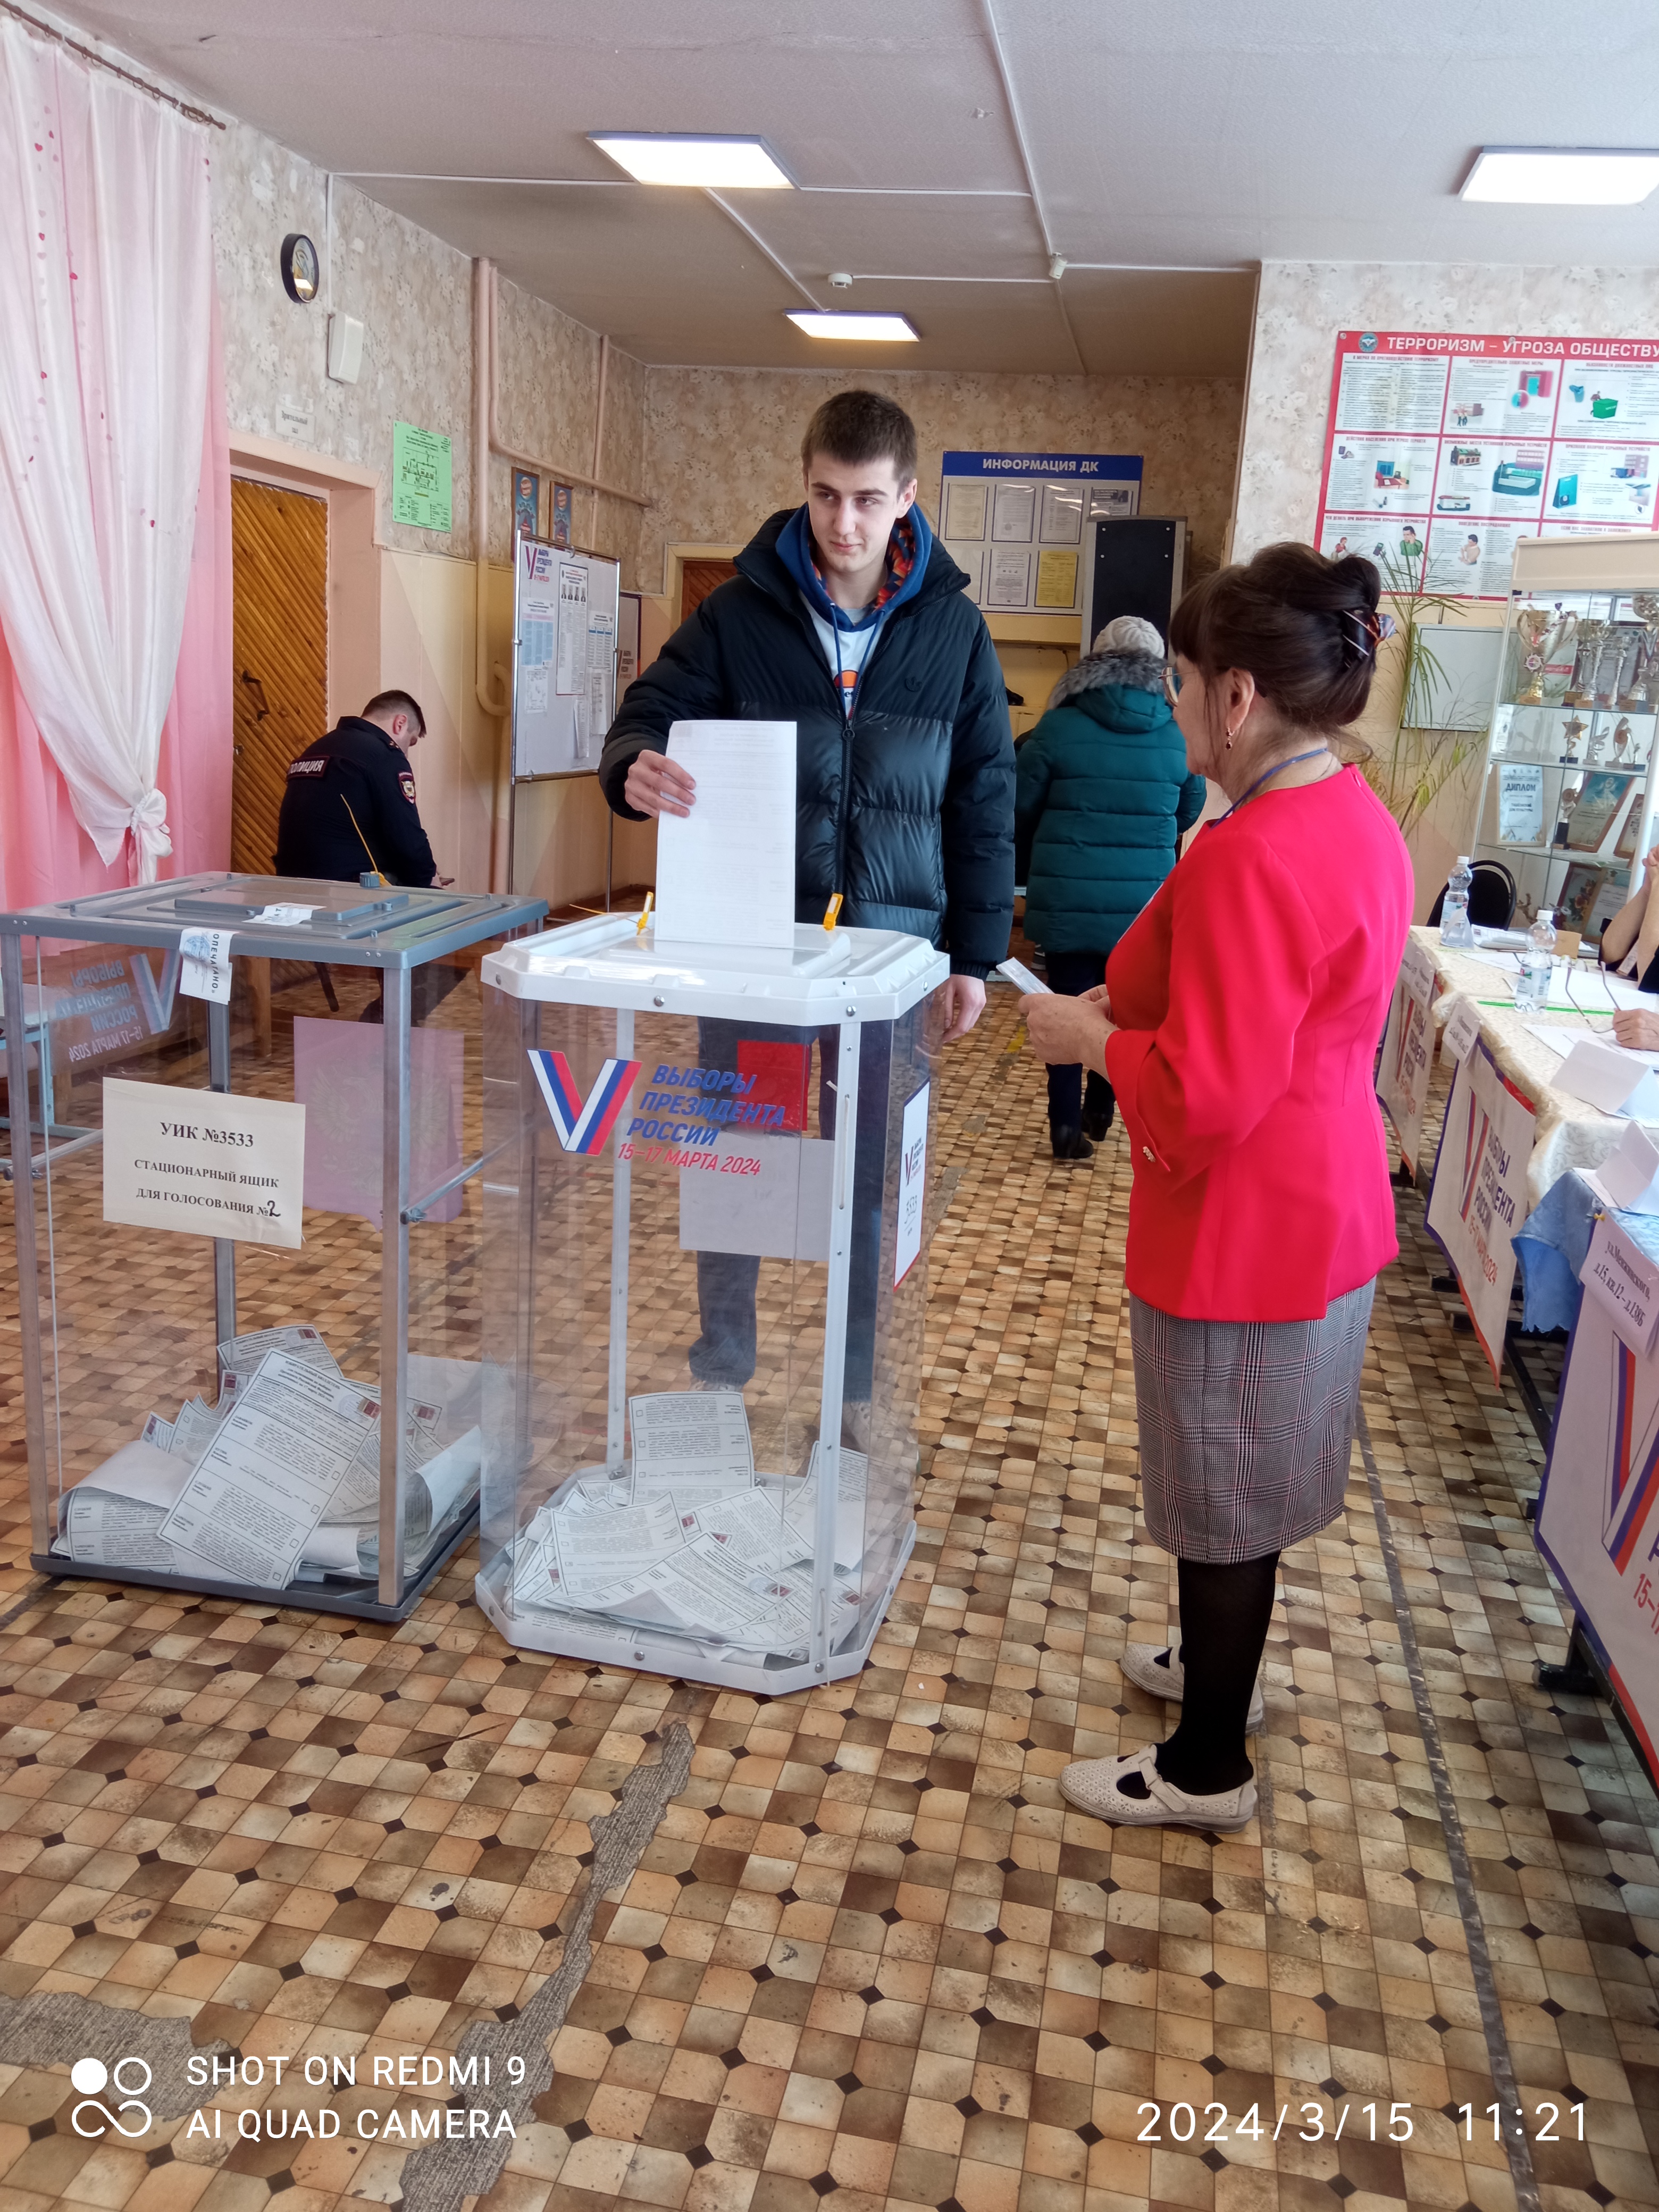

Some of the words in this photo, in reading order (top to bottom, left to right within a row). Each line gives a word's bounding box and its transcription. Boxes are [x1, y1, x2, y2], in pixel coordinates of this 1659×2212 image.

[1387, 337, 1485, 352] ТЕРРОРИЗМ
[1503, 340, 1565, 355] УГРОЗА
[983, 459, 1076, 472] ИНФОРМАЦИЯ
[1080, 462, 1099, 473] ДК
[1505, 783, 1536, 792] ДИПЛОМ
[651, 1064, 757, 1094] ВЫБОРЫ
[639, 1091, 785, 1126] ПРЕЗИДЕНТА
[160, 1122, 198, 1139] УИК
[202, 1128, 254, 1147] №3533
[626, 1118, 721, 1146] РОССИИ
[135, 1159, 236, 1182] СТАЦИОНАРНЫЙ
[239, 1175, 279, 1188] ЯЩИК
[663, 1148, 718, 1171] МАРТА
[720, 1155, 761, 1176] 2024
[136, 1188, 161, 1200] ДЛЯ
[164, 1192, 253, 1214] ГОЛОСОВАНИЯ
